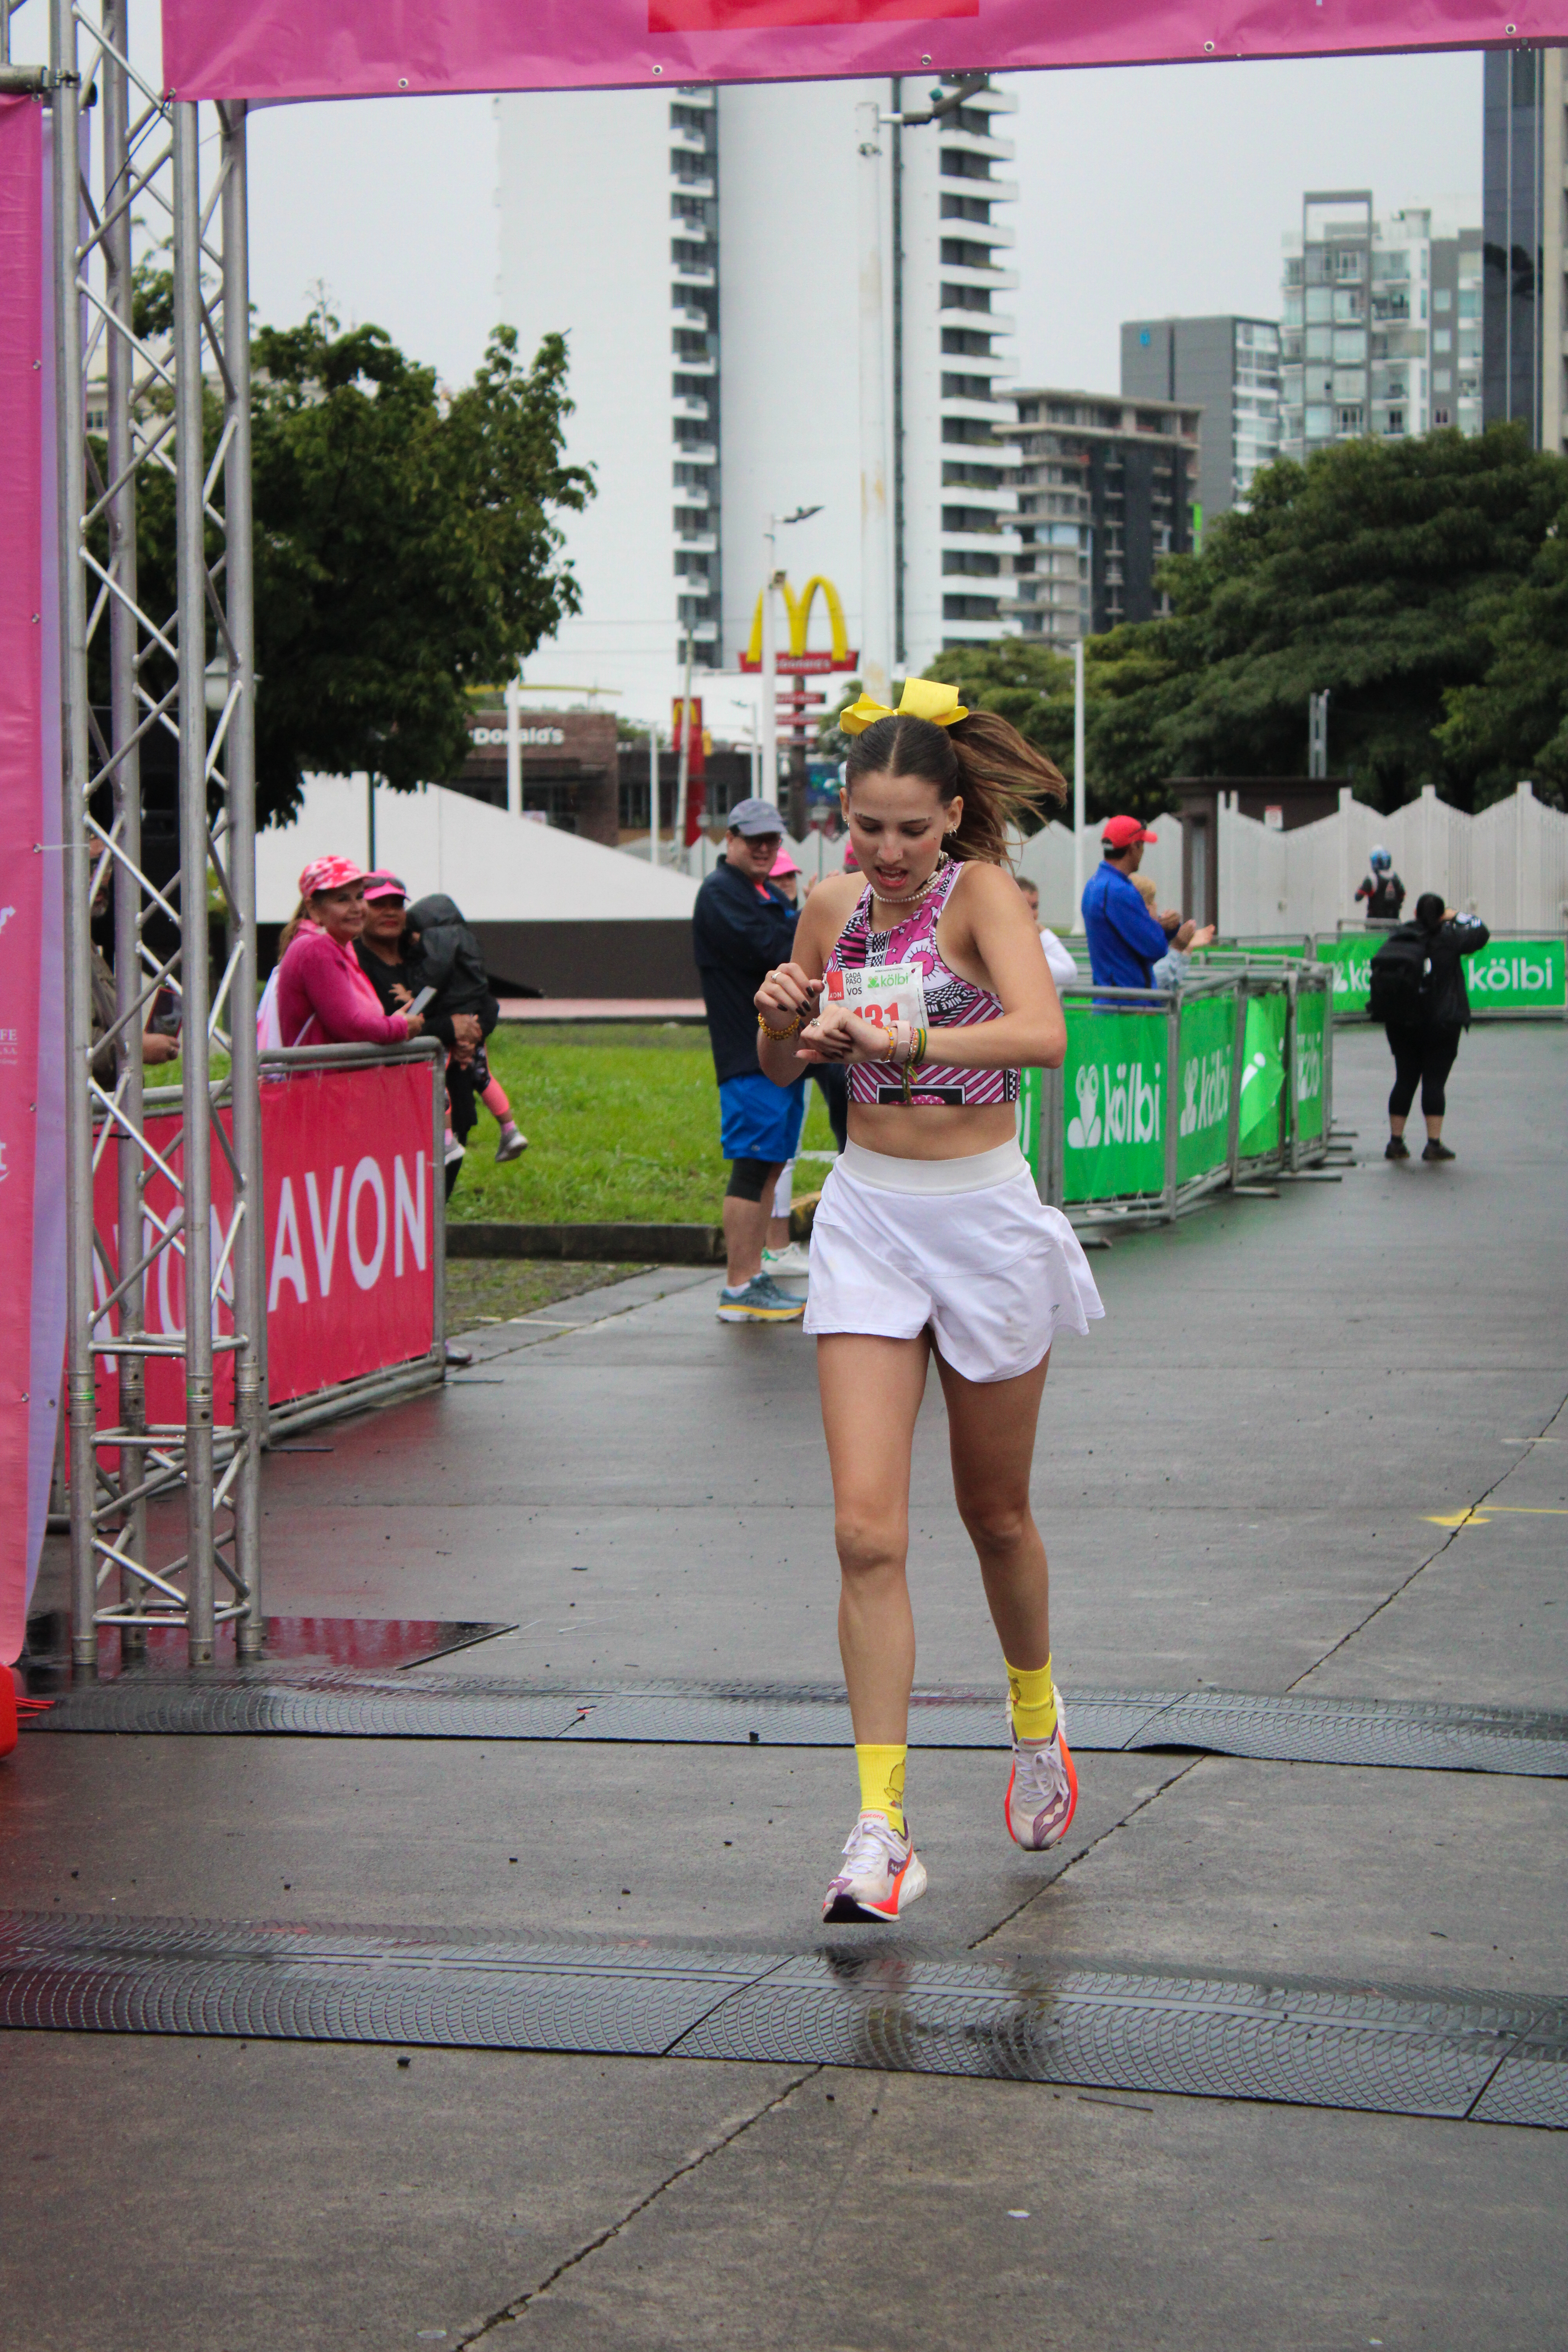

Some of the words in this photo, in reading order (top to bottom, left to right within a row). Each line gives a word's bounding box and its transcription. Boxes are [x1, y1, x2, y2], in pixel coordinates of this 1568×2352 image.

[468, 727, 564, 744] Doald's
[880, 973, 909, 987] kölbi
[1468, 957, 1553, 991] kölbi
[847, 987, 862, 996] VOS
[927, 1004, 939, 1013] NI
[940, 996, 962, 1010] NIKE
[1103, 1062, 1161, 1146] kölbi
[267, 1150, 426, 1312] AVON
